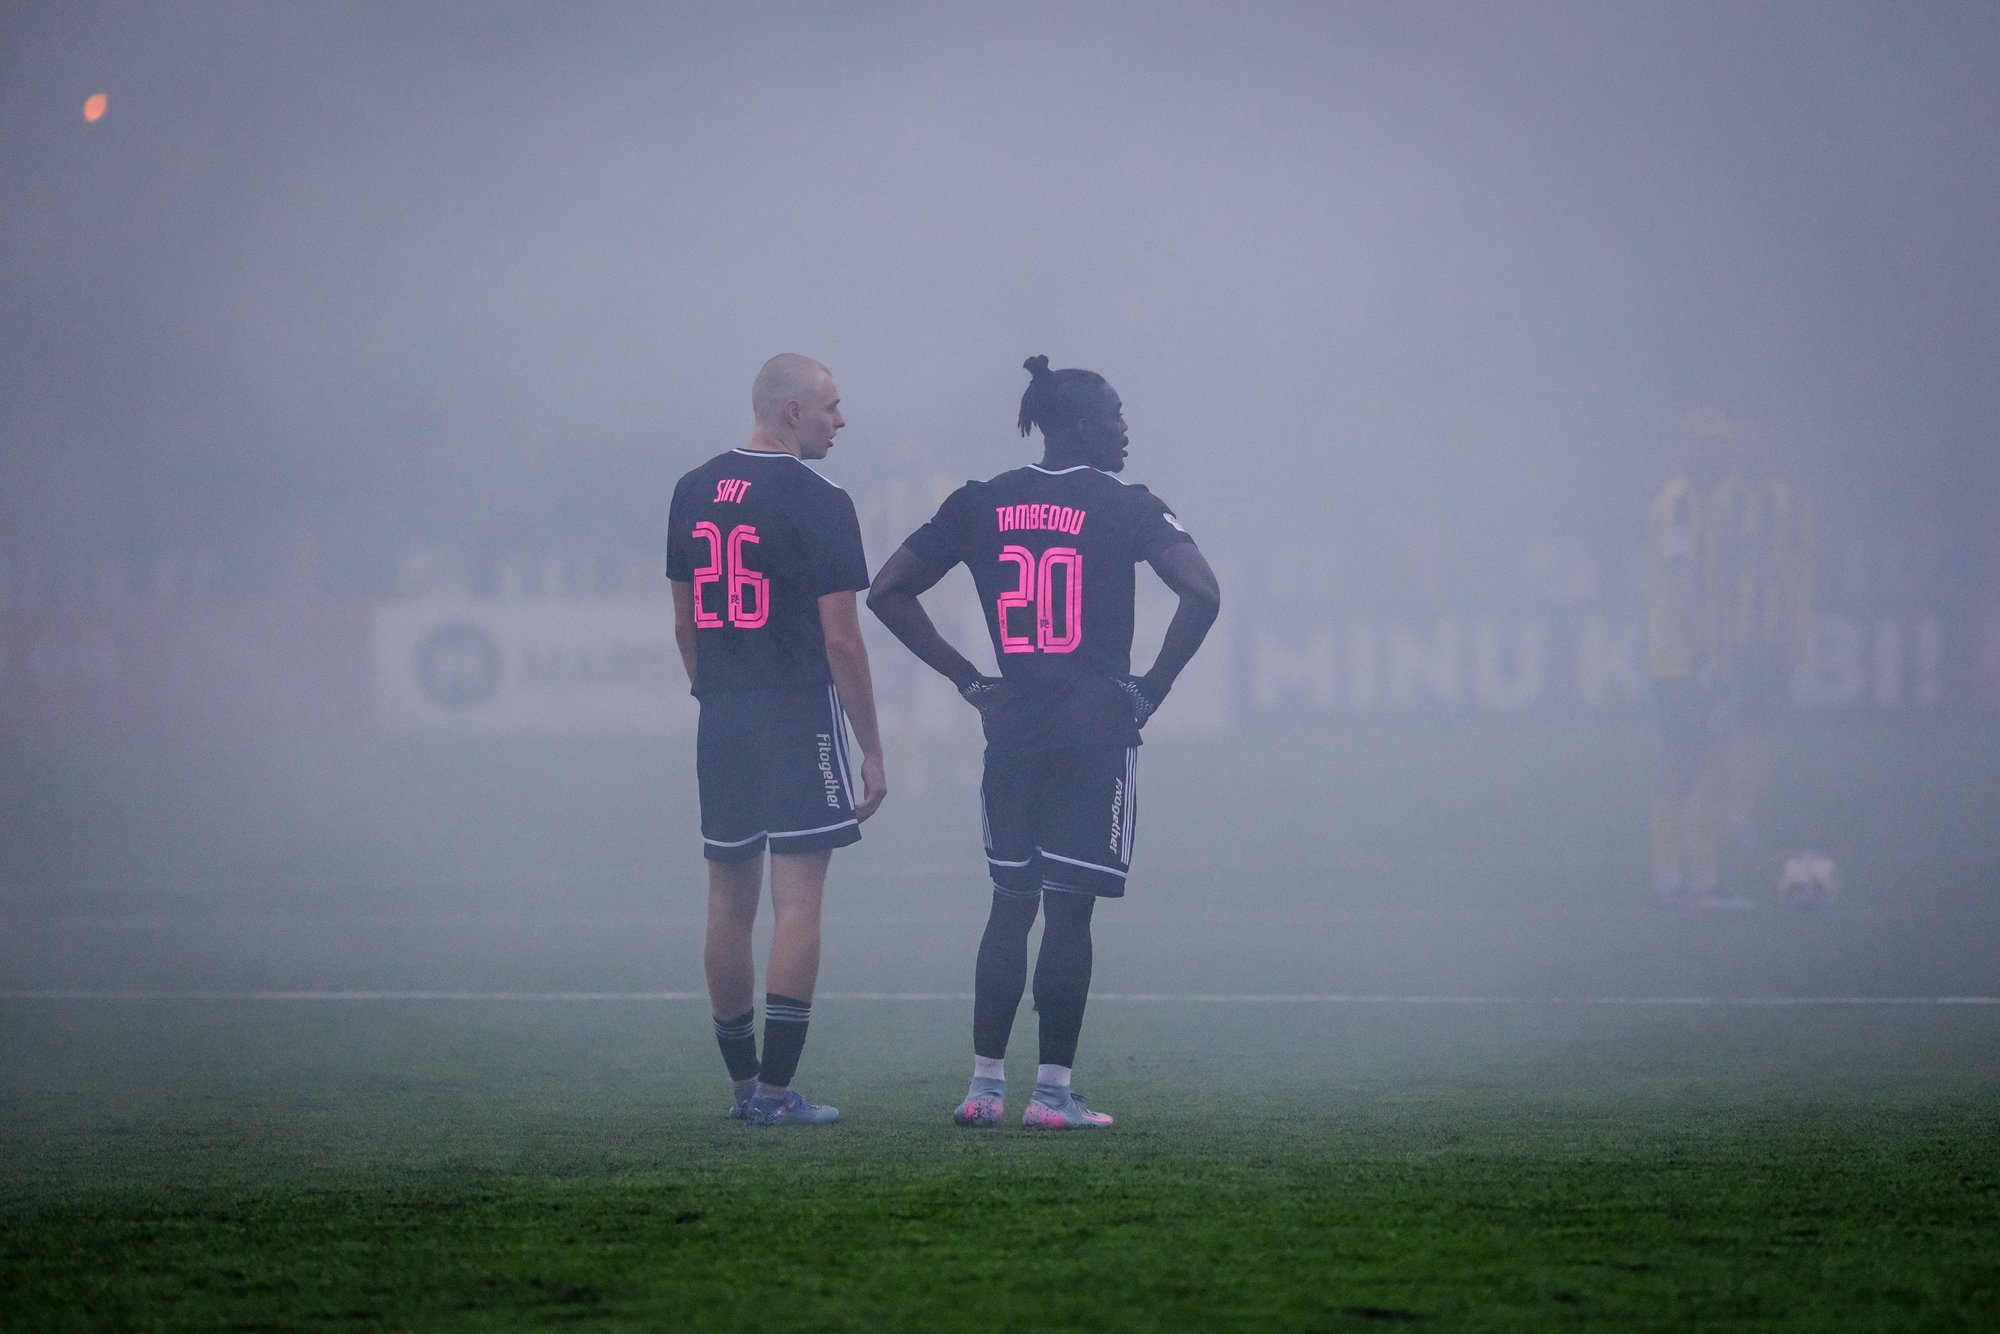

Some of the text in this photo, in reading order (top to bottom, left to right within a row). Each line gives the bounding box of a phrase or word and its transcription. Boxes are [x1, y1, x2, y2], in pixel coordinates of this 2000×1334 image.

[713, 478, 752, 504] SIHT
[995, 504, 1086, 536] TAMBEDOU
[691, 521, 770, 629] 26
[997, 545, 1083, 654] 20
[1253, 616, 1544, 709] MINU
[816, 733, 840, 809] Fitogether
